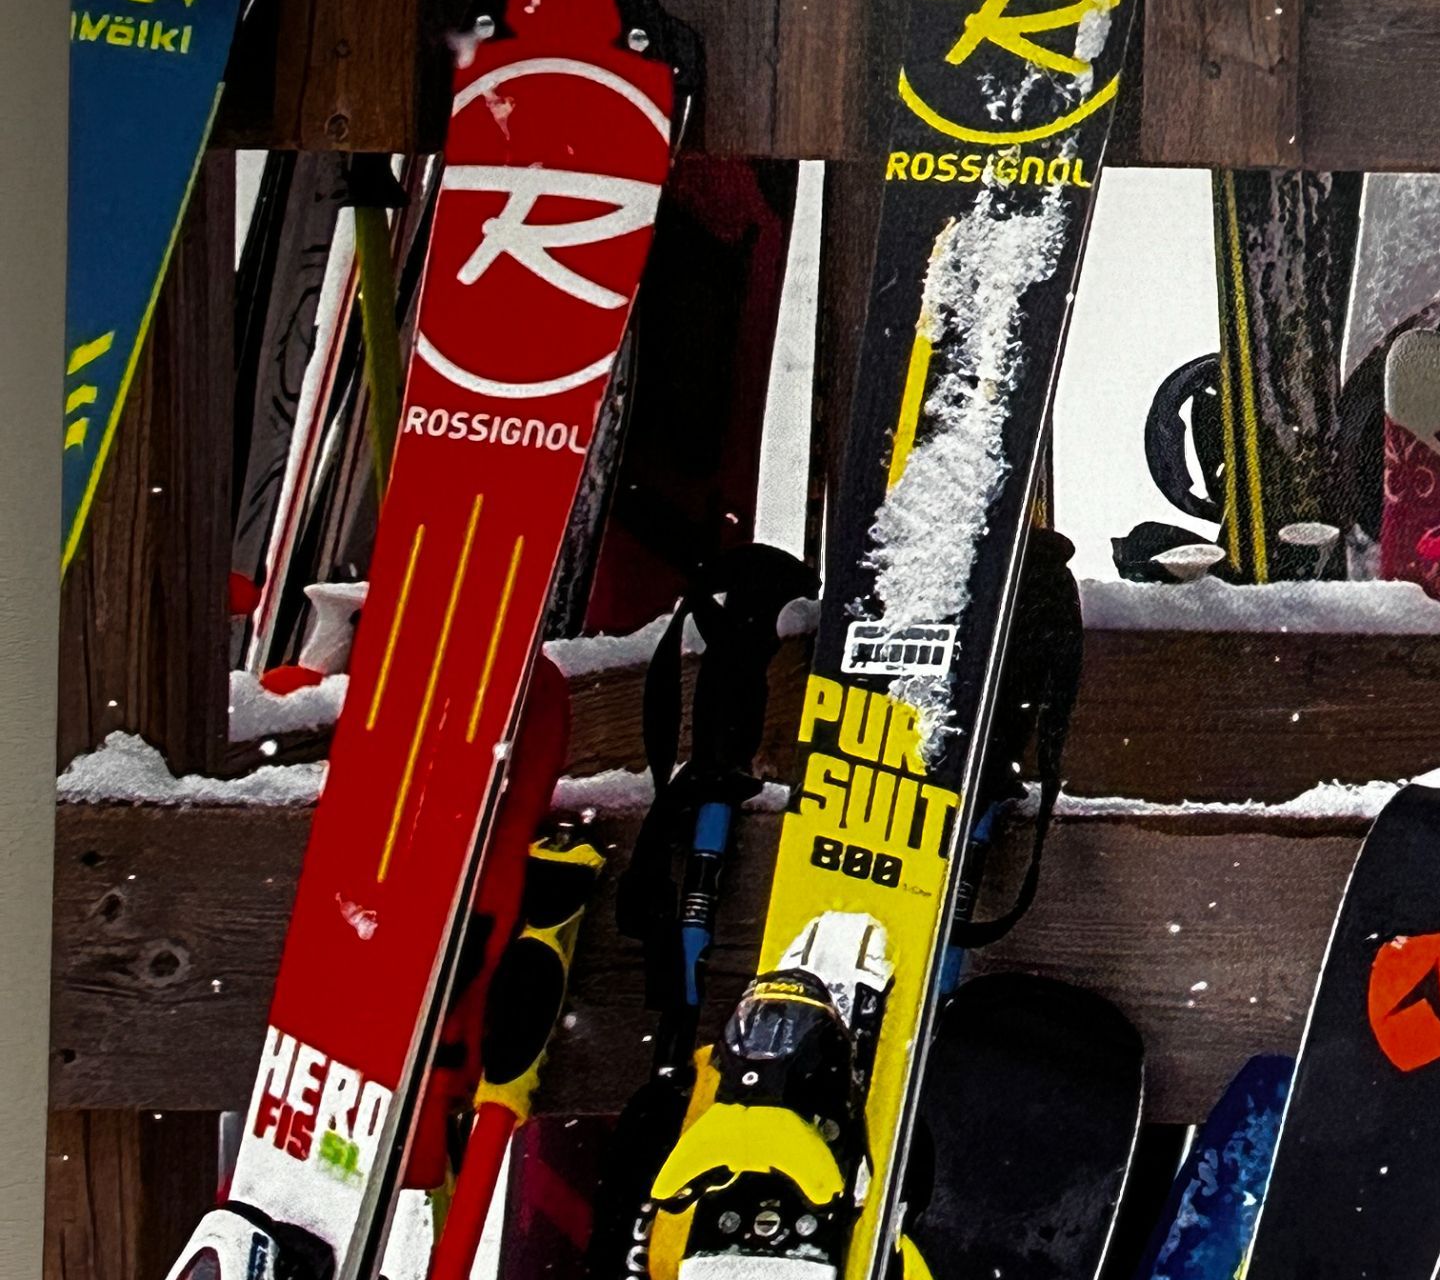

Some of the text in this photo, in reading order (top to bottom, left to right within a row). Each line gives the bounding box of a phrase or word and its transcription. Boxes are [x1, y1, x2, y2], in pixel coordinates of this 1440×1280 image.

[884, 151, 1094, 189] ROSSIGNOL
[403, 406, 587, 455] ROSSIGNOL
[799, 751, 960, 860] SUIT
[810, 834, 903, 889] 800
[255, 1023, 394, 1140] HERO
[253, 1090, 315, 1161] FIS
